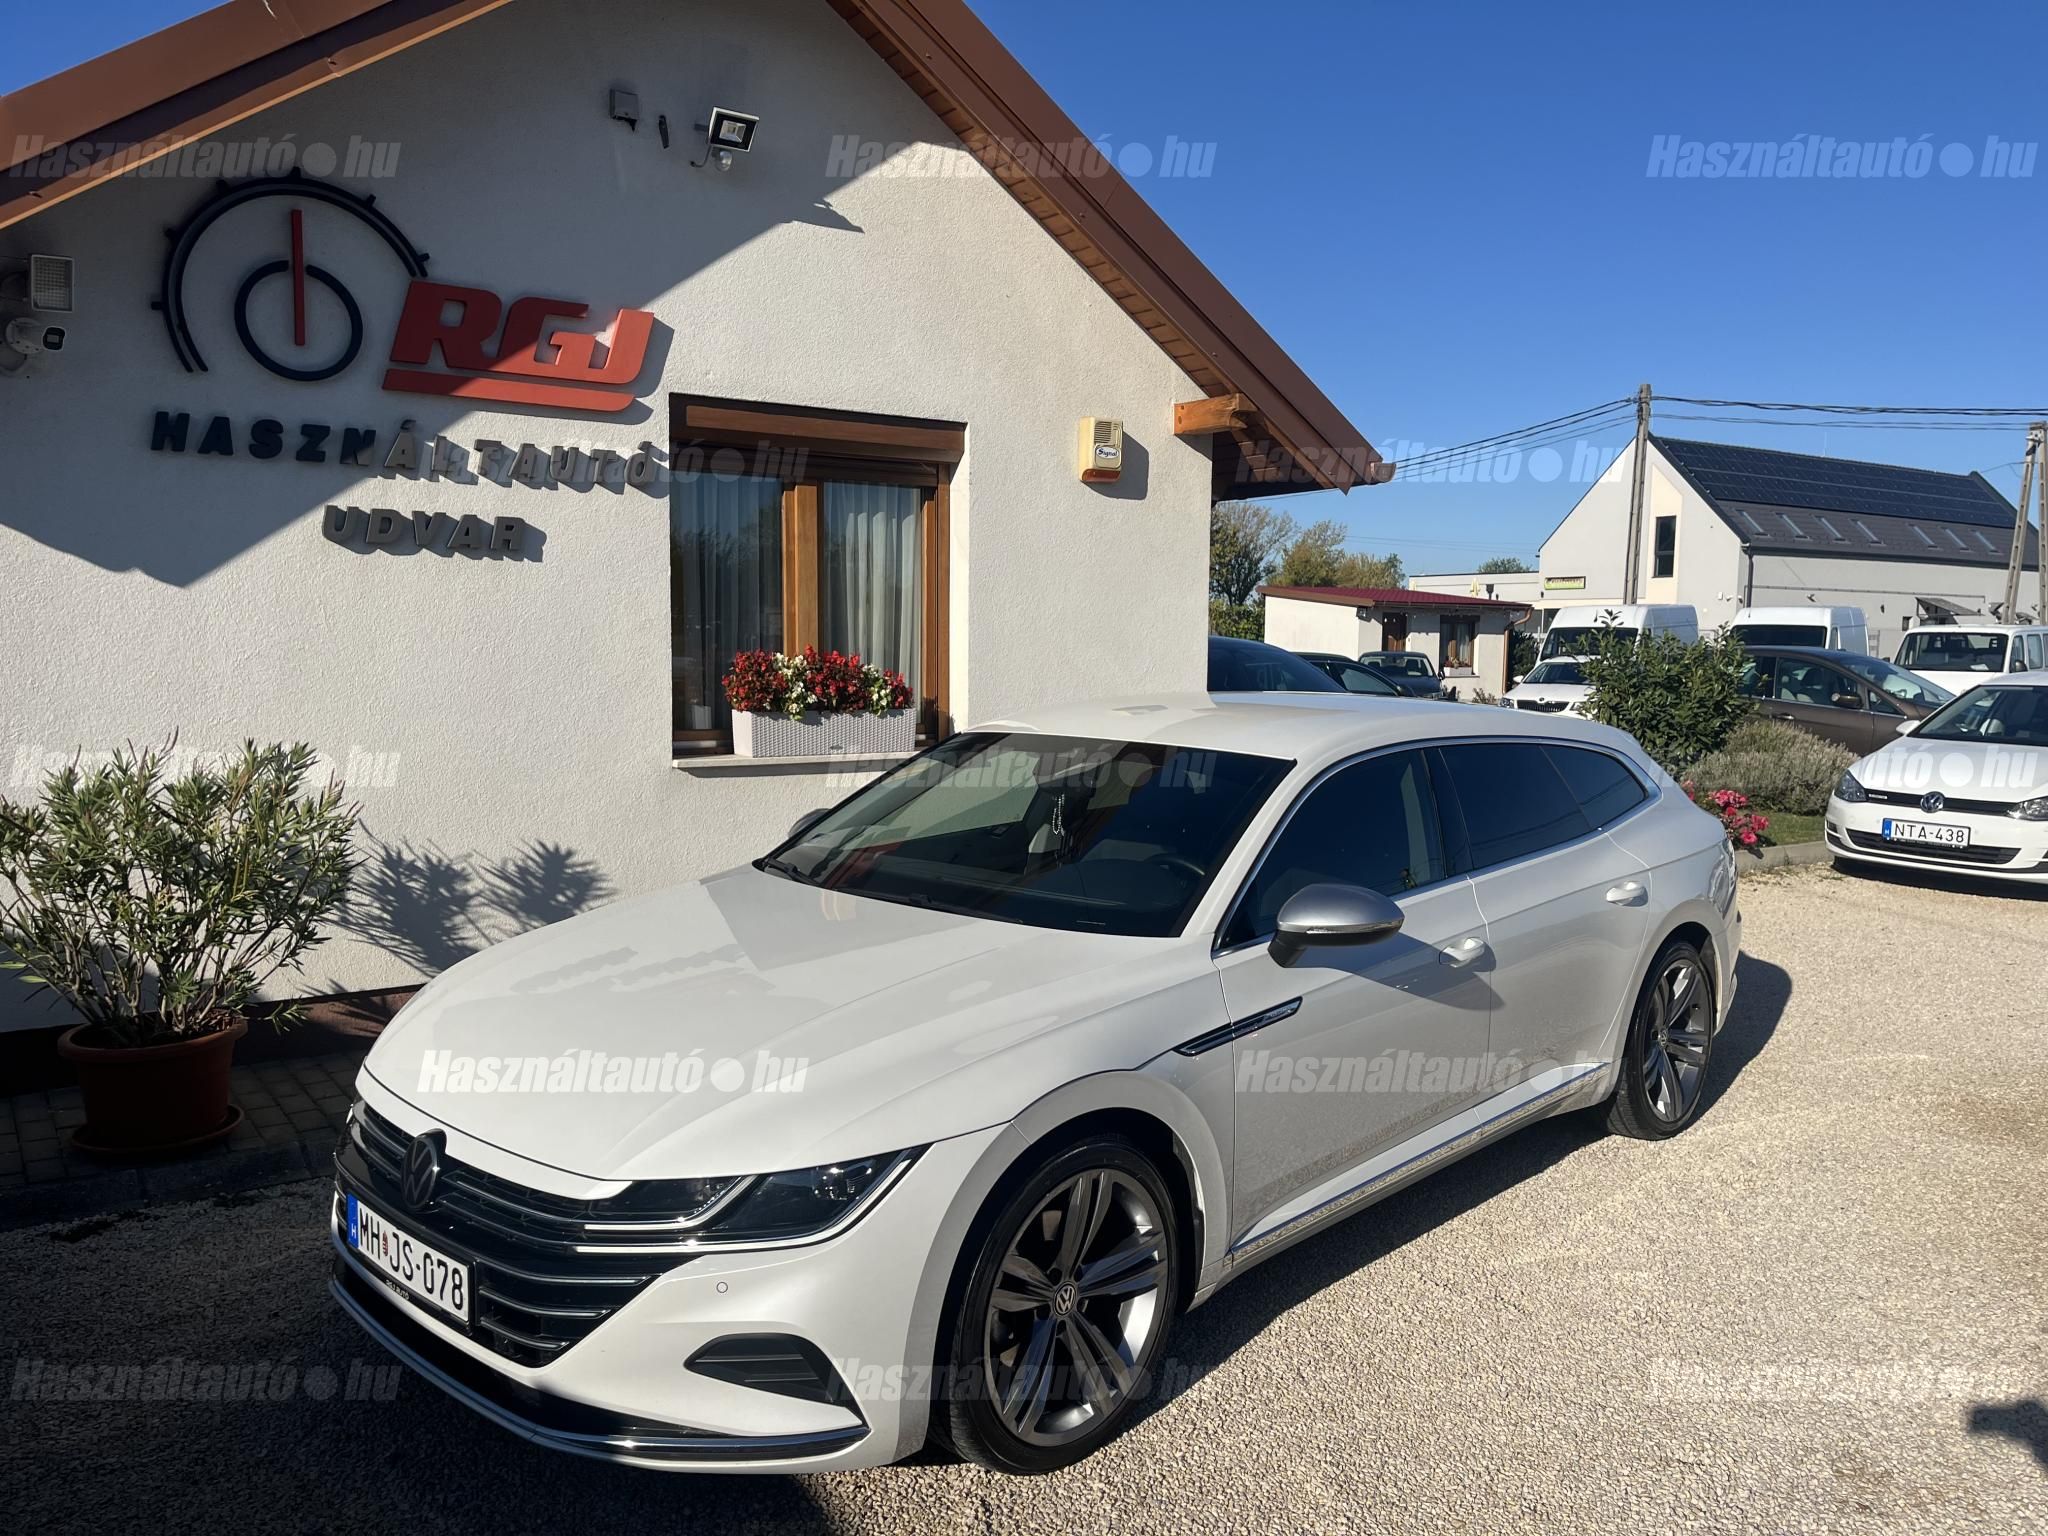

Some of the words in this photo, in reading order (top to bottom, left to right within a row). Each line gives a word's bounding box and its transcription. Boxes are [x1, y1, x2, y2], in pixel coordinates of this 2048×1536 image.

[390, 281, 655, 384] RGJ
[1097, 448, 1118, 458] Signal
[322, 505, 524, 551] UDVAR
[1894, 823, 1965, 843] NTA-438
